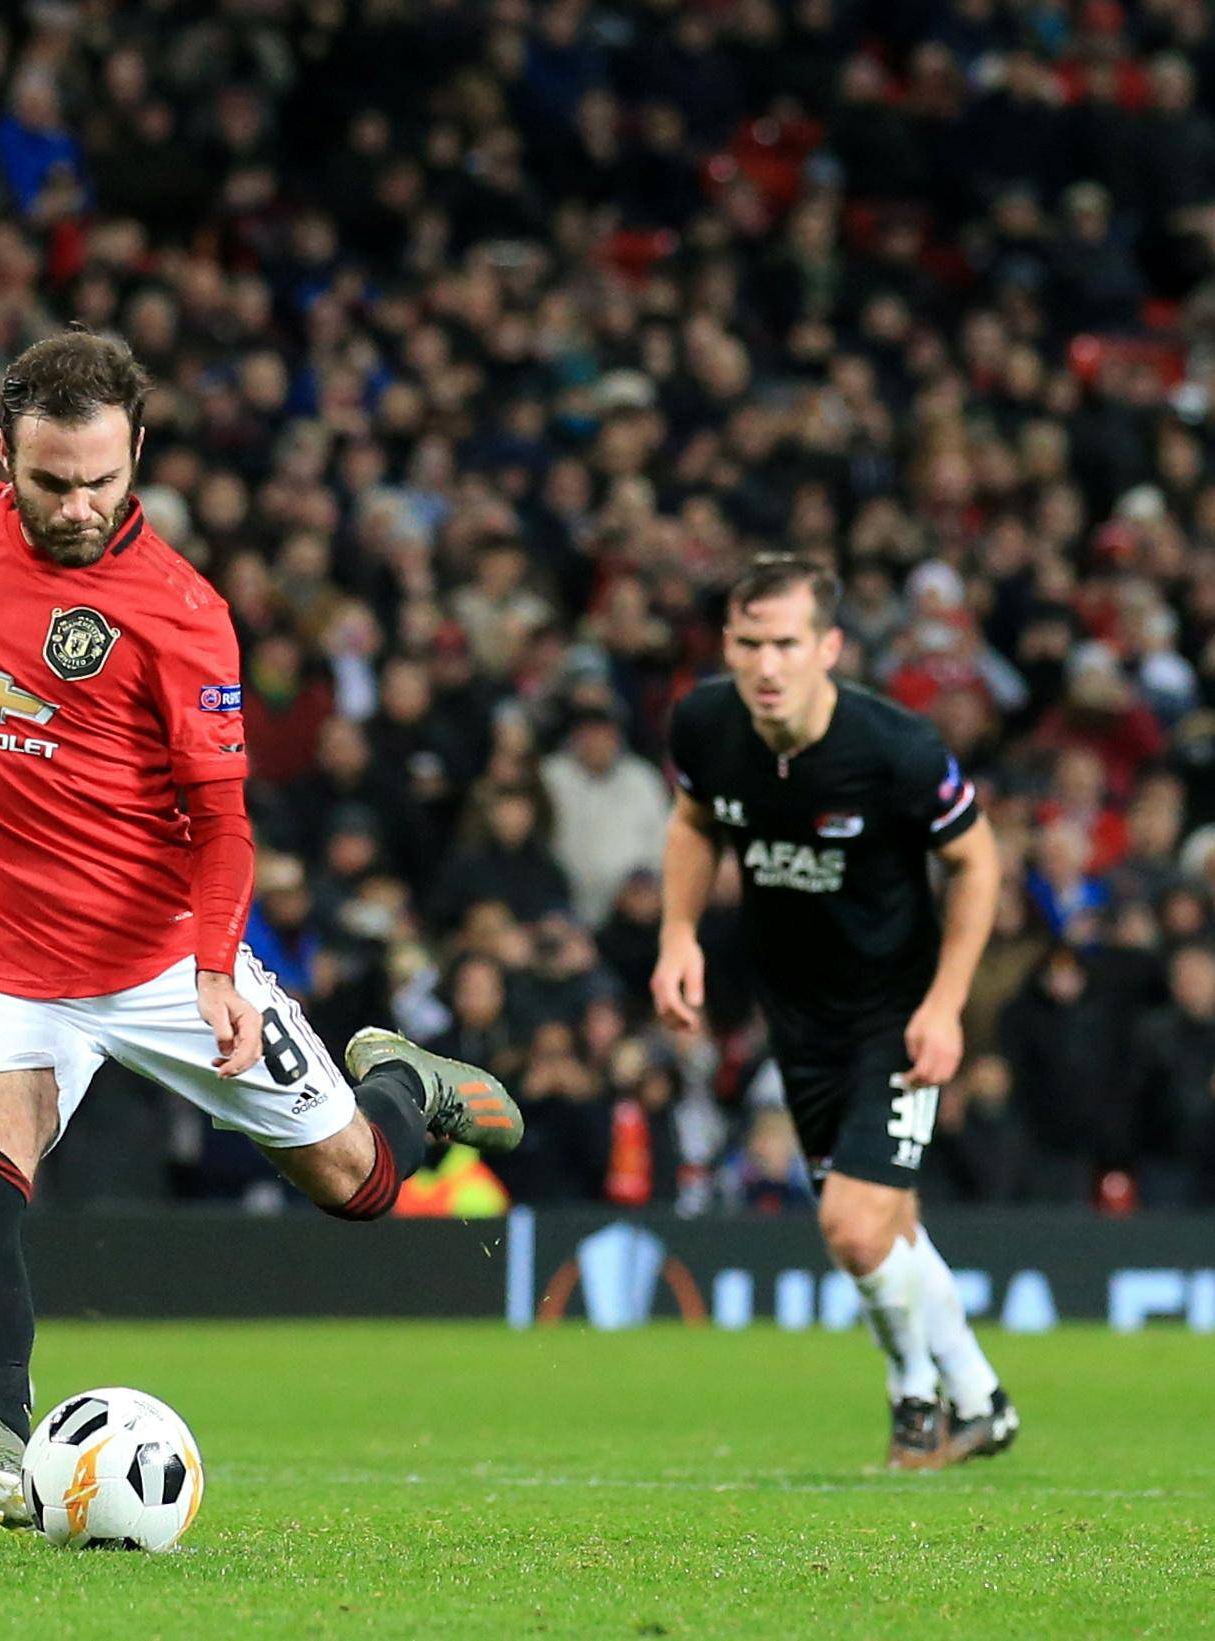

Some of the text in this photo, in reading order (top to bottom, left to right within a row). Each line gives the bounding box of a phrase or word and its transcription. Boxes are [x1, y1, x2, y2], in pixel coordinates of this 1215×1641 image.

[744, 839, 846, 880] AFAS
[261, 1006, 308, 1087] 8
[291, 1092, 328, 1115] adidas
